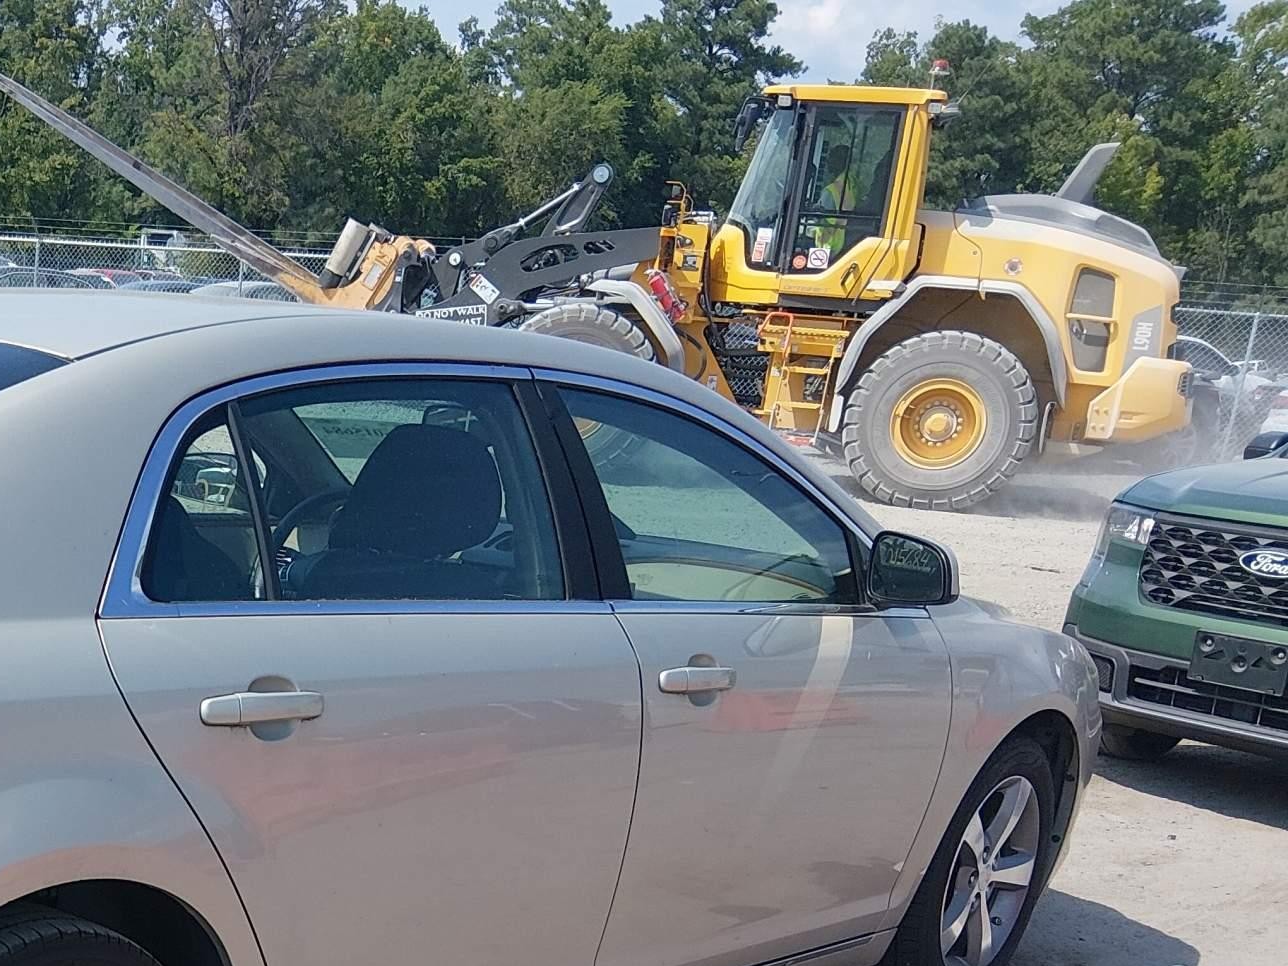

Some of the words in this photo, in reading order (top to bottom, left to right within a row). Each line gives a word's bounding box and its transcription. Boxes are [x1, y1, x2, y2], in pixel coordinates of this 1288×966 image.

[433, 309, 454, 319] NOT
[456, 306, 486, 316] WALK
[1132, 321, 1154, 351] L90H
